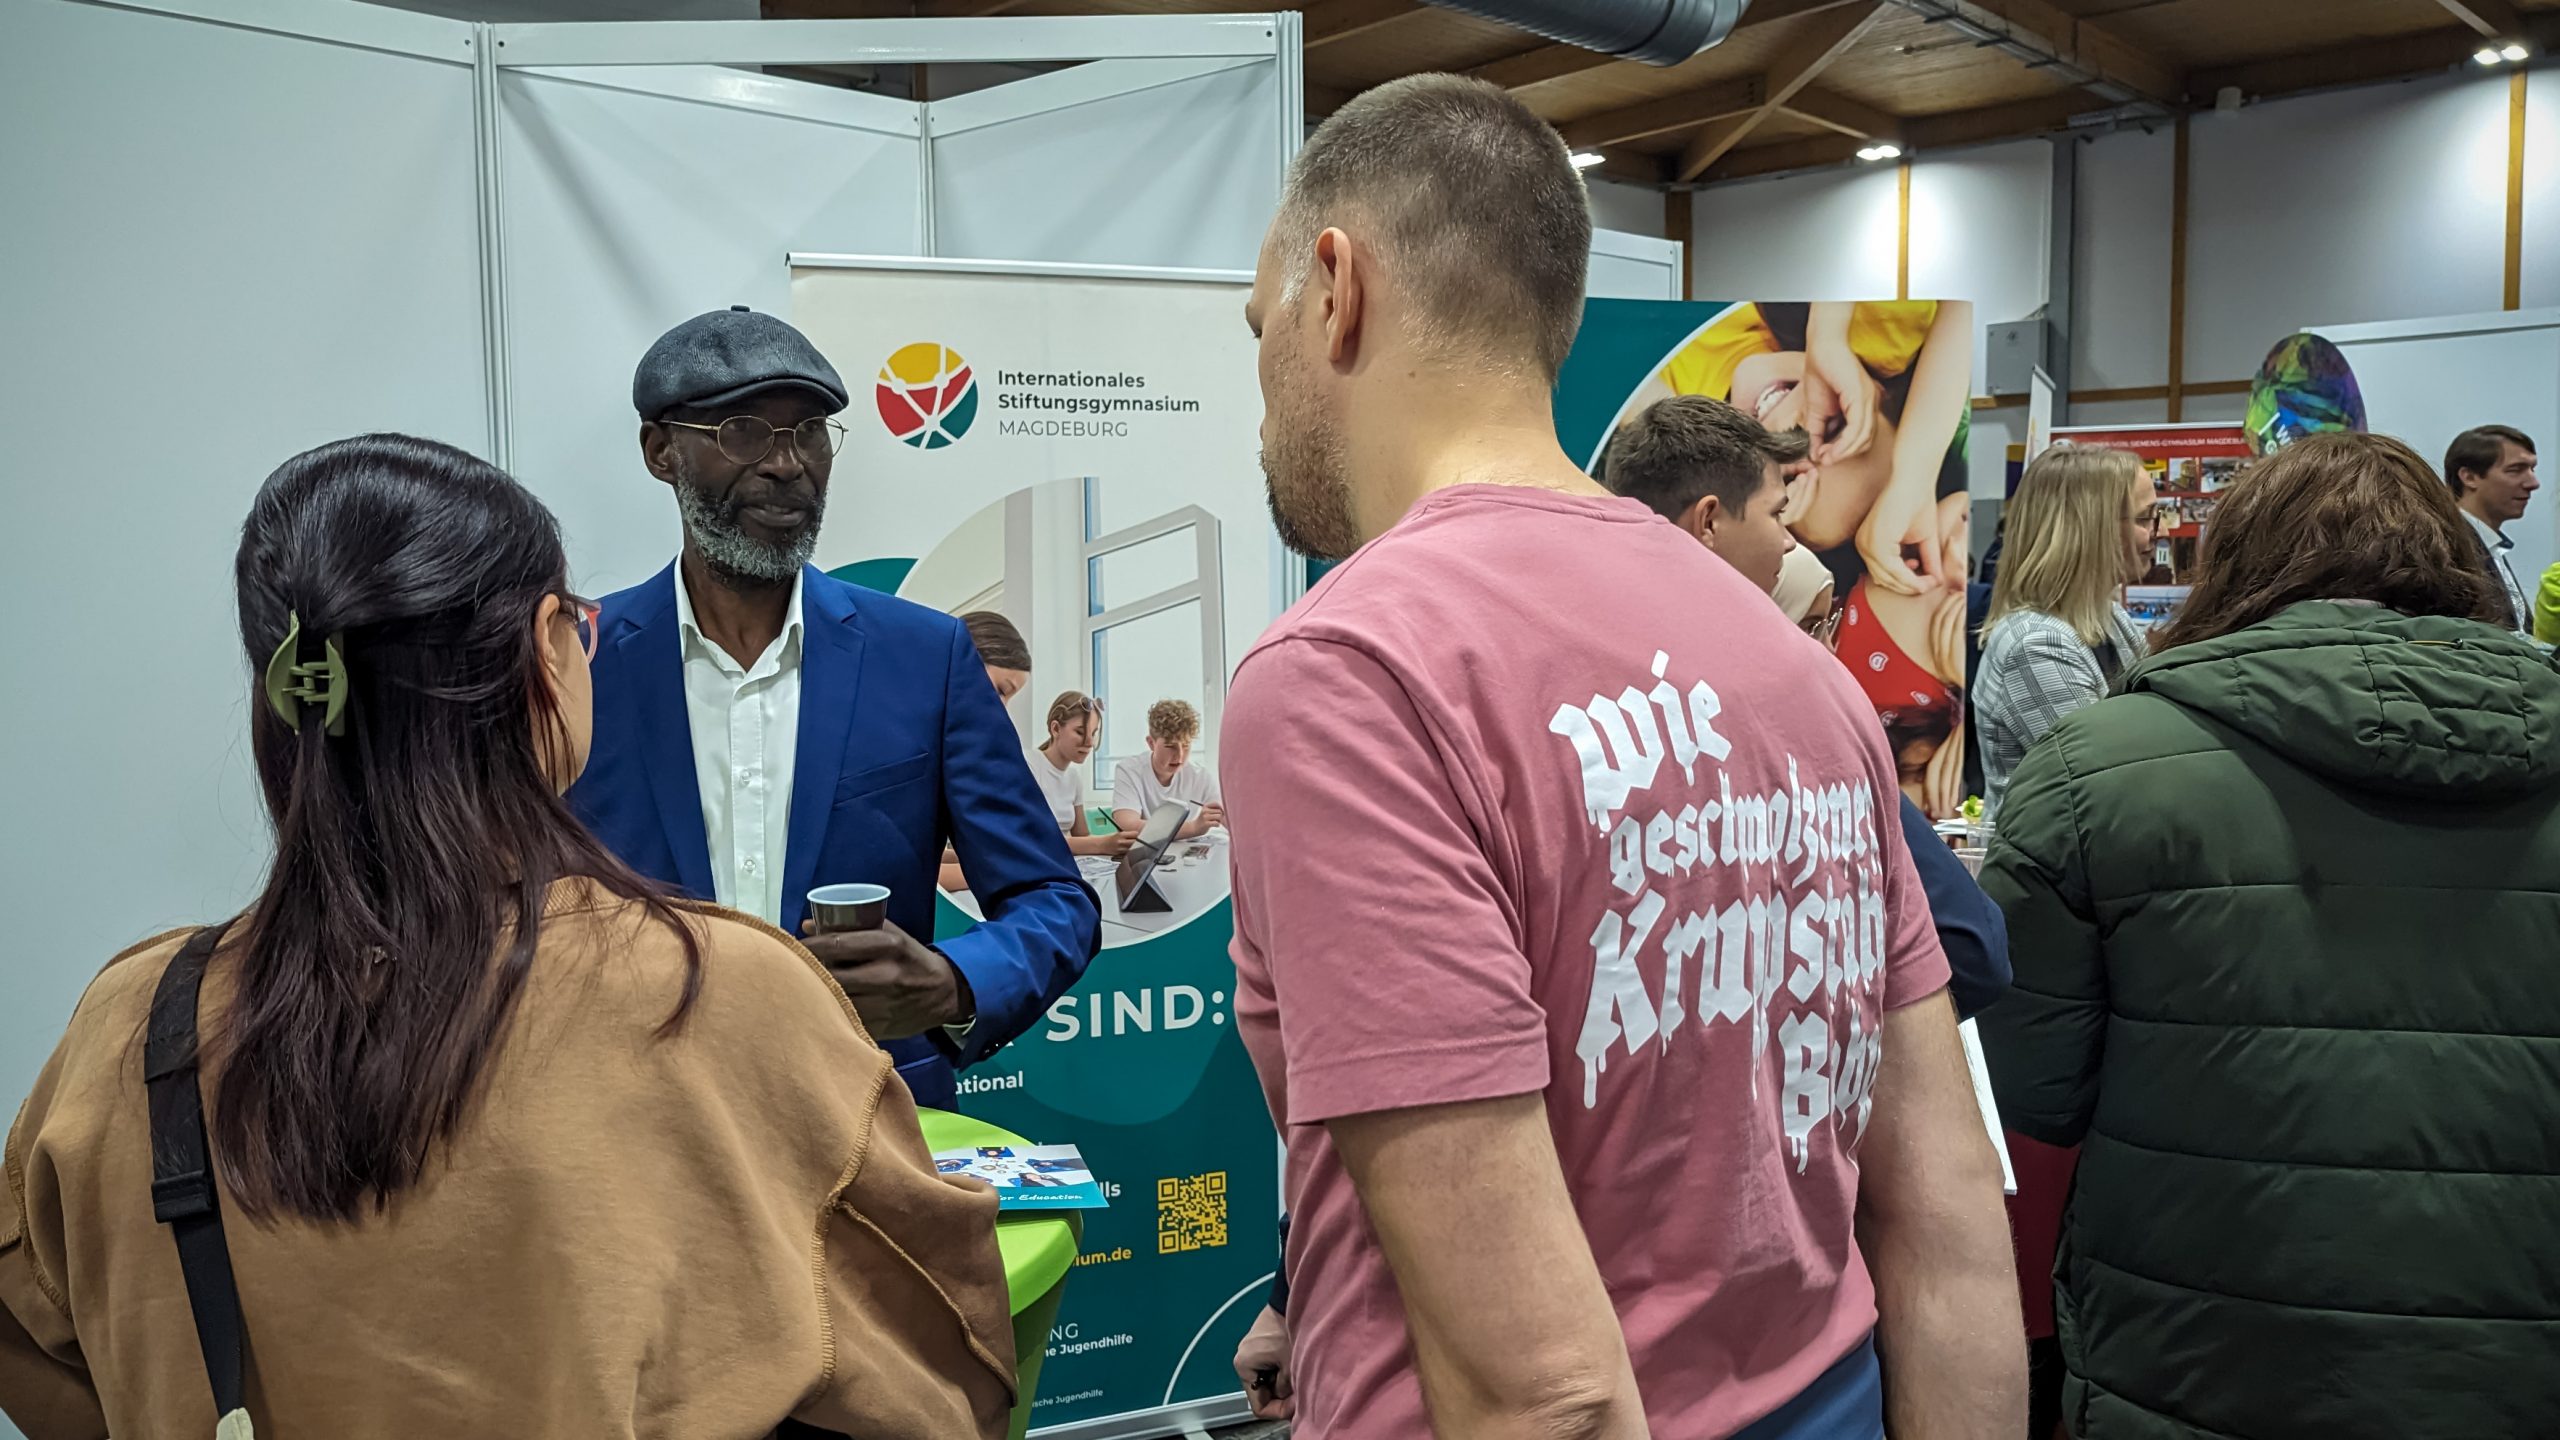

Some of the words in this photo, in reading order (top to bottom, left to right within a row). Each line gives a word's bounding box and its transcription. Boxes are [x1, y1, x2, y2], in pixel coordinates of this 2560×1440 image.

[998, 370, 1145, 388] Internationales
[998, 393, 1200, 414] Stiftungsgymnasium
[999, 420, 1129, 437] MAGDEBURG
[1046, 985, 1225, 1042] SIND:
[1059, 1333, 1133, 1355] Jugendhilfe
[1055, 1389, 1104, 1404] Jugendhilfe
